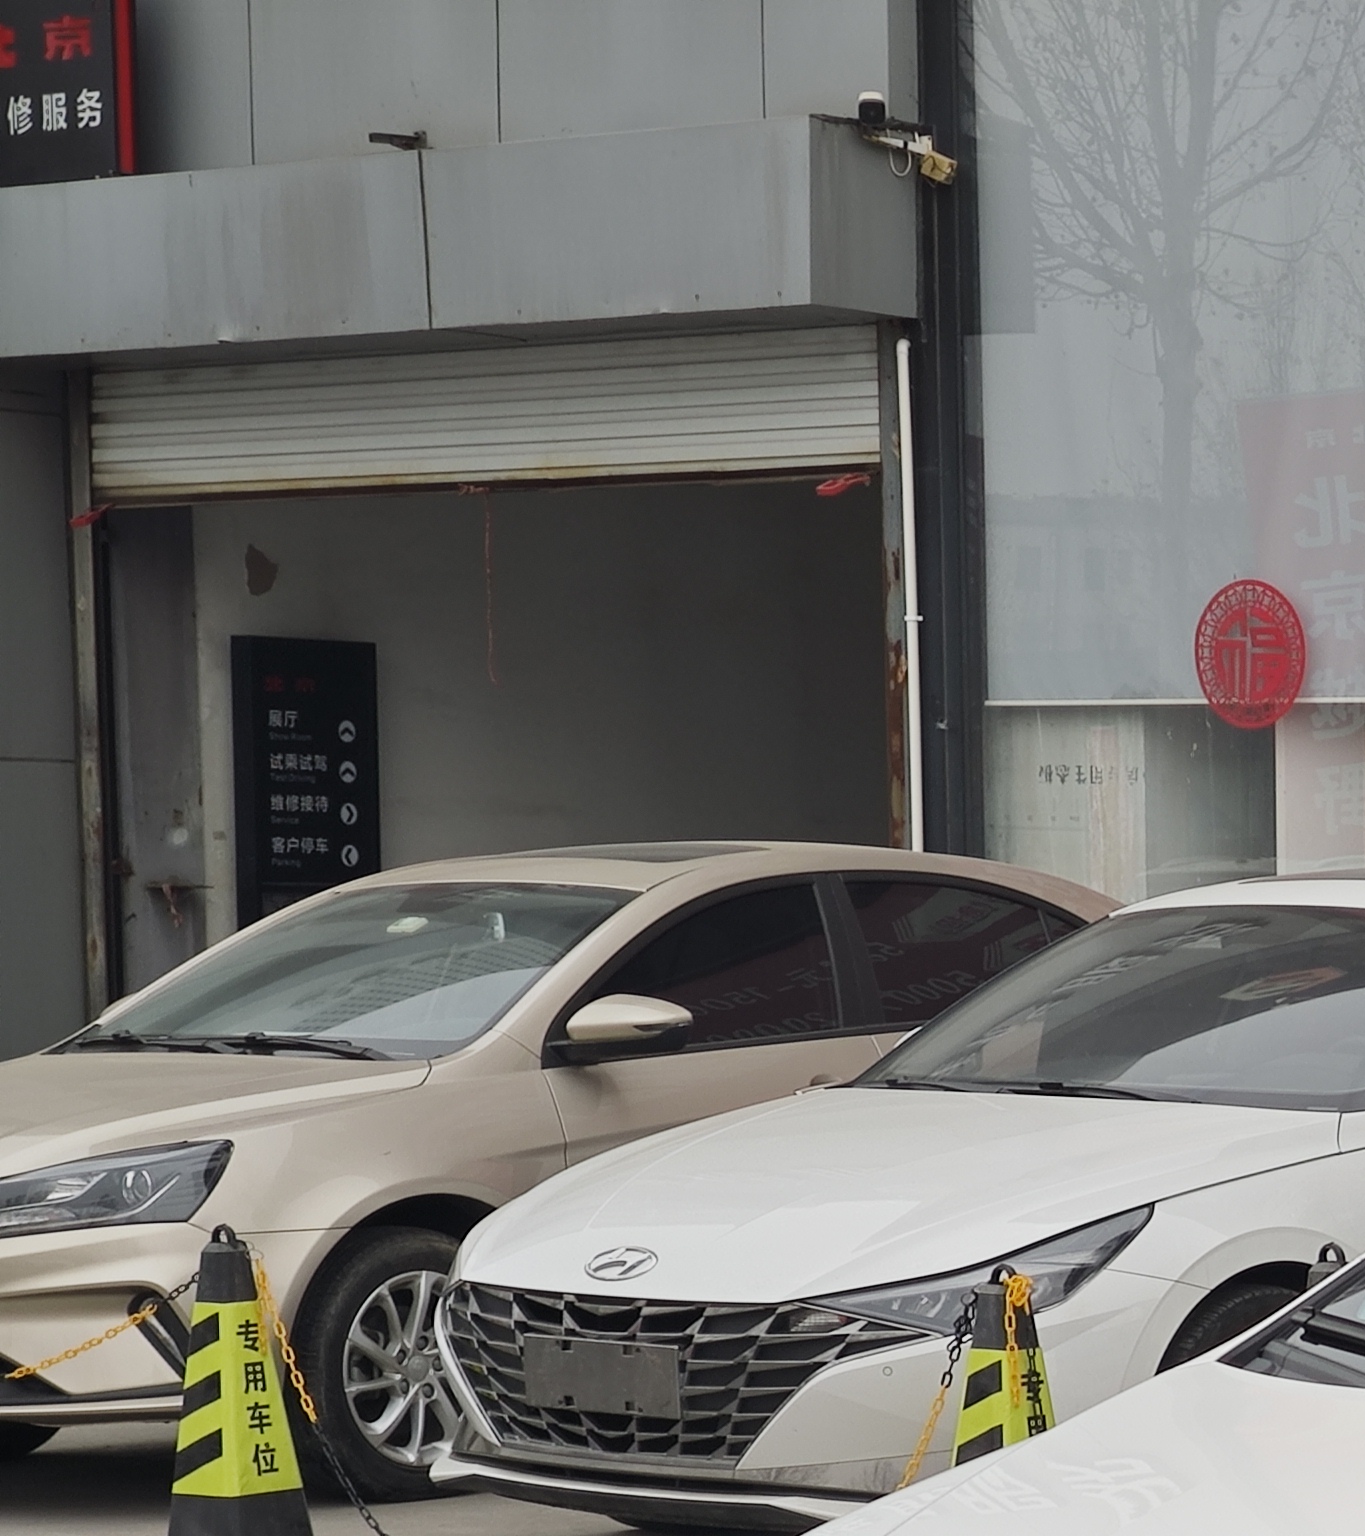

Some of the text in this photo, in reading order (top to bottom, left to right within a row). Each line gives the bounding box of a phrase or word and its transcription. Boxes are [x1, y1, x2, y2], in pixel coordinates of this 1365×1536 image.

[7, 88, 102, 135] 修服务
[268, 710, 298, 728] 展厅
[270, 753, 328, 772] 试乘试驾
[270, 795, 329, 813] 维修接待
[271, 837, 329, 854] 客户停车
[237, 1319, 279, 1477] 专用车位
